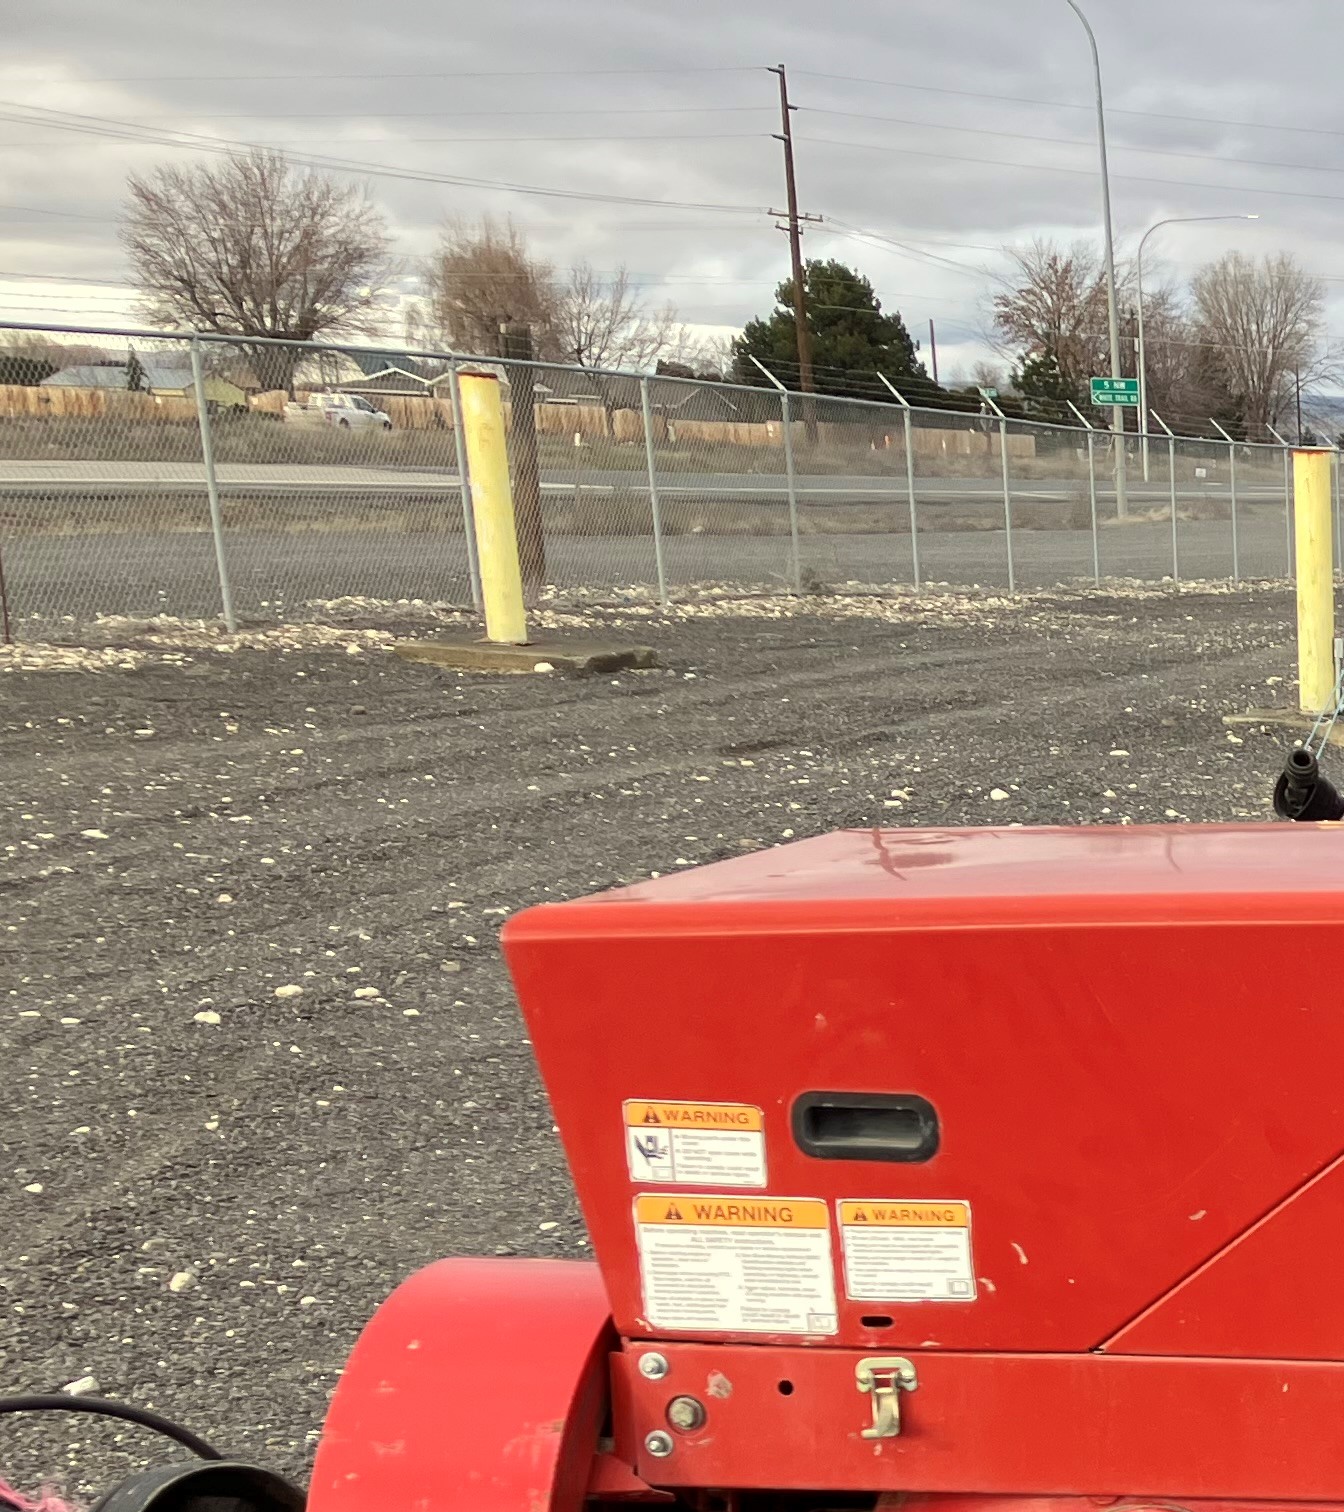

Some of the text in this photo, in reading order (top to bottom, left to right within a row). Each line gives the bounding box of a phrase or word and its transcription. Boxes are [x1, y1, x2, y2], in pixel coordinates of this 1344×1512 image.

[663, 1109, 749, 1124] WARNING
[693, 1204, 794, 1222] WARNING
[872, 1209, 955, 1222] WARNING
